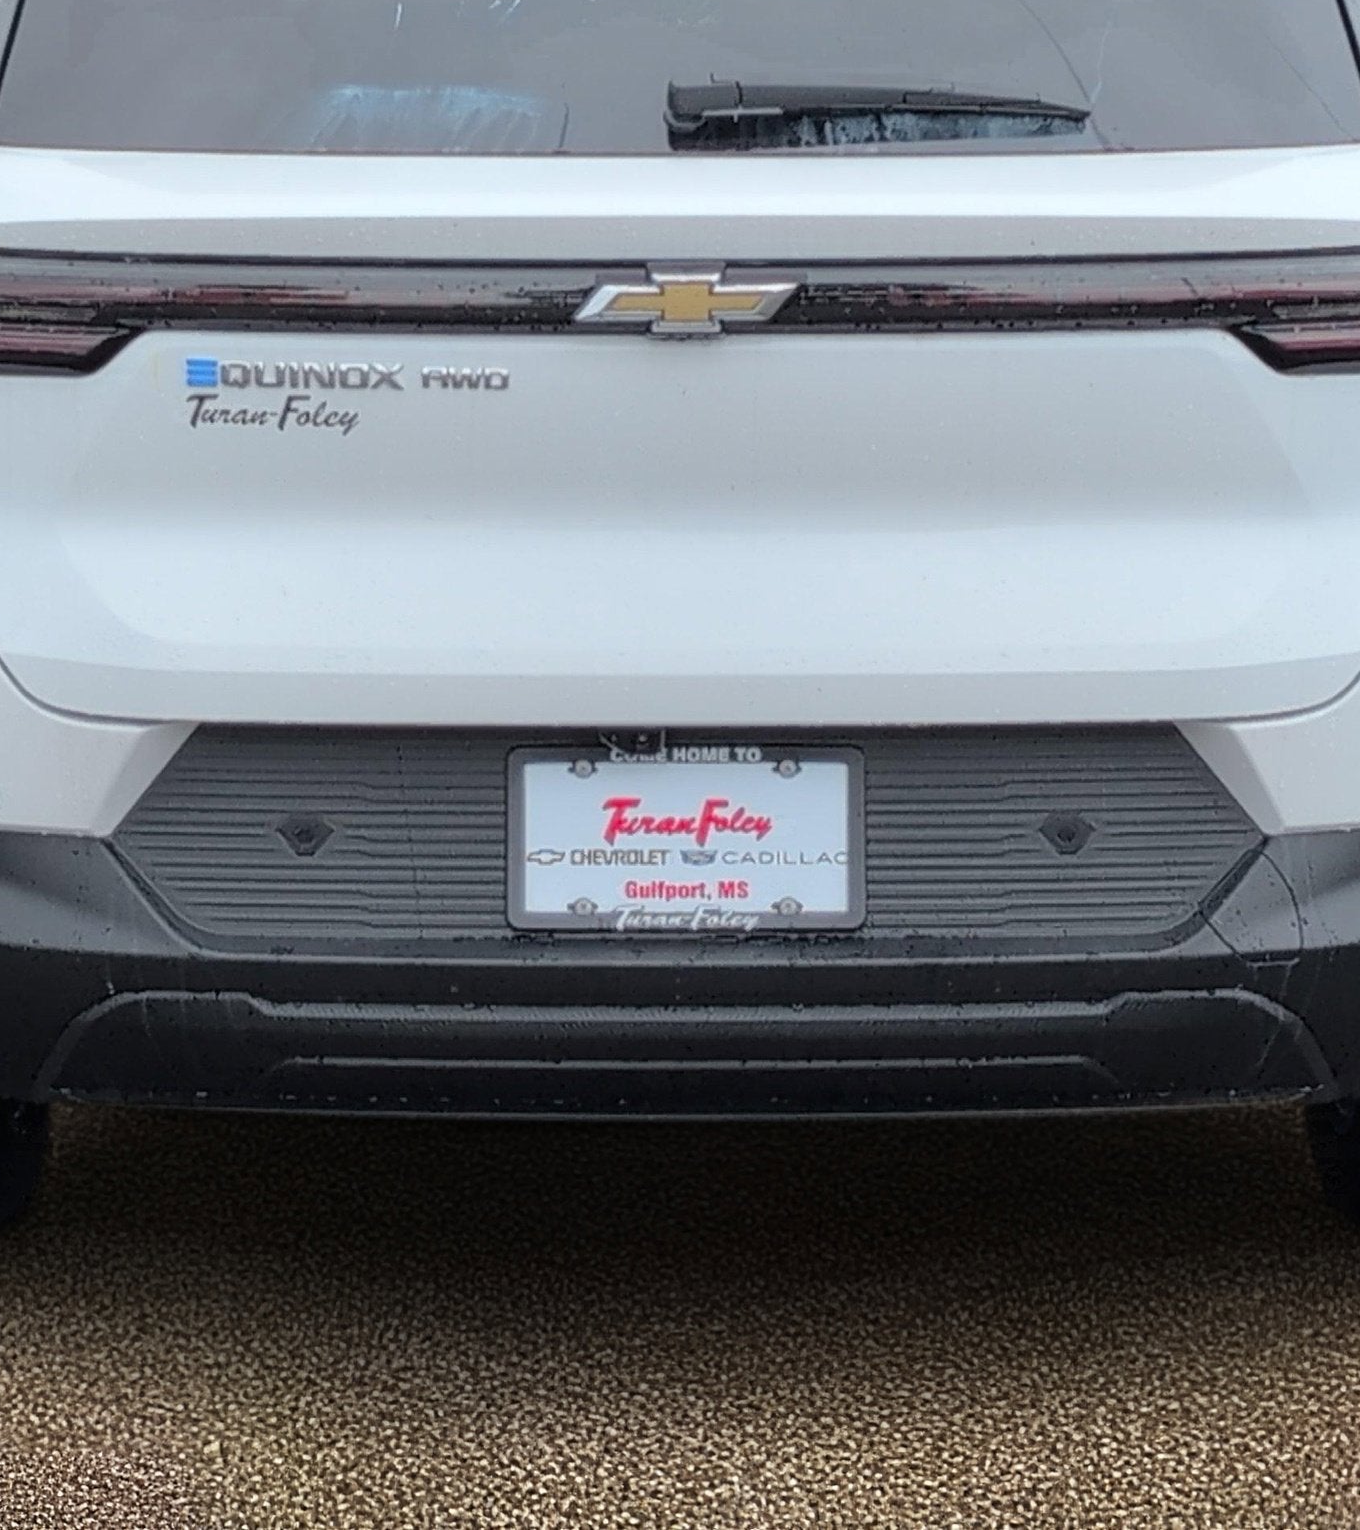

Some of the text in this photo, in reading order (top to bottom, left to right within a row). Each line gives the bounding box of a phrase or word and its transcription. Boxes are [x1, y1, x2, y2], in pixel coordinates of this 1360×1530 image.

[185, 358, 511, 391] EQUINOX AWD
[673, 746, 730, 762] HOME
[734, 746, 762, 762] TO
[570, 849, 848, 866] CHEVROLET CADILLAC
[624, 880, 750, 902] Gulfport, MS
